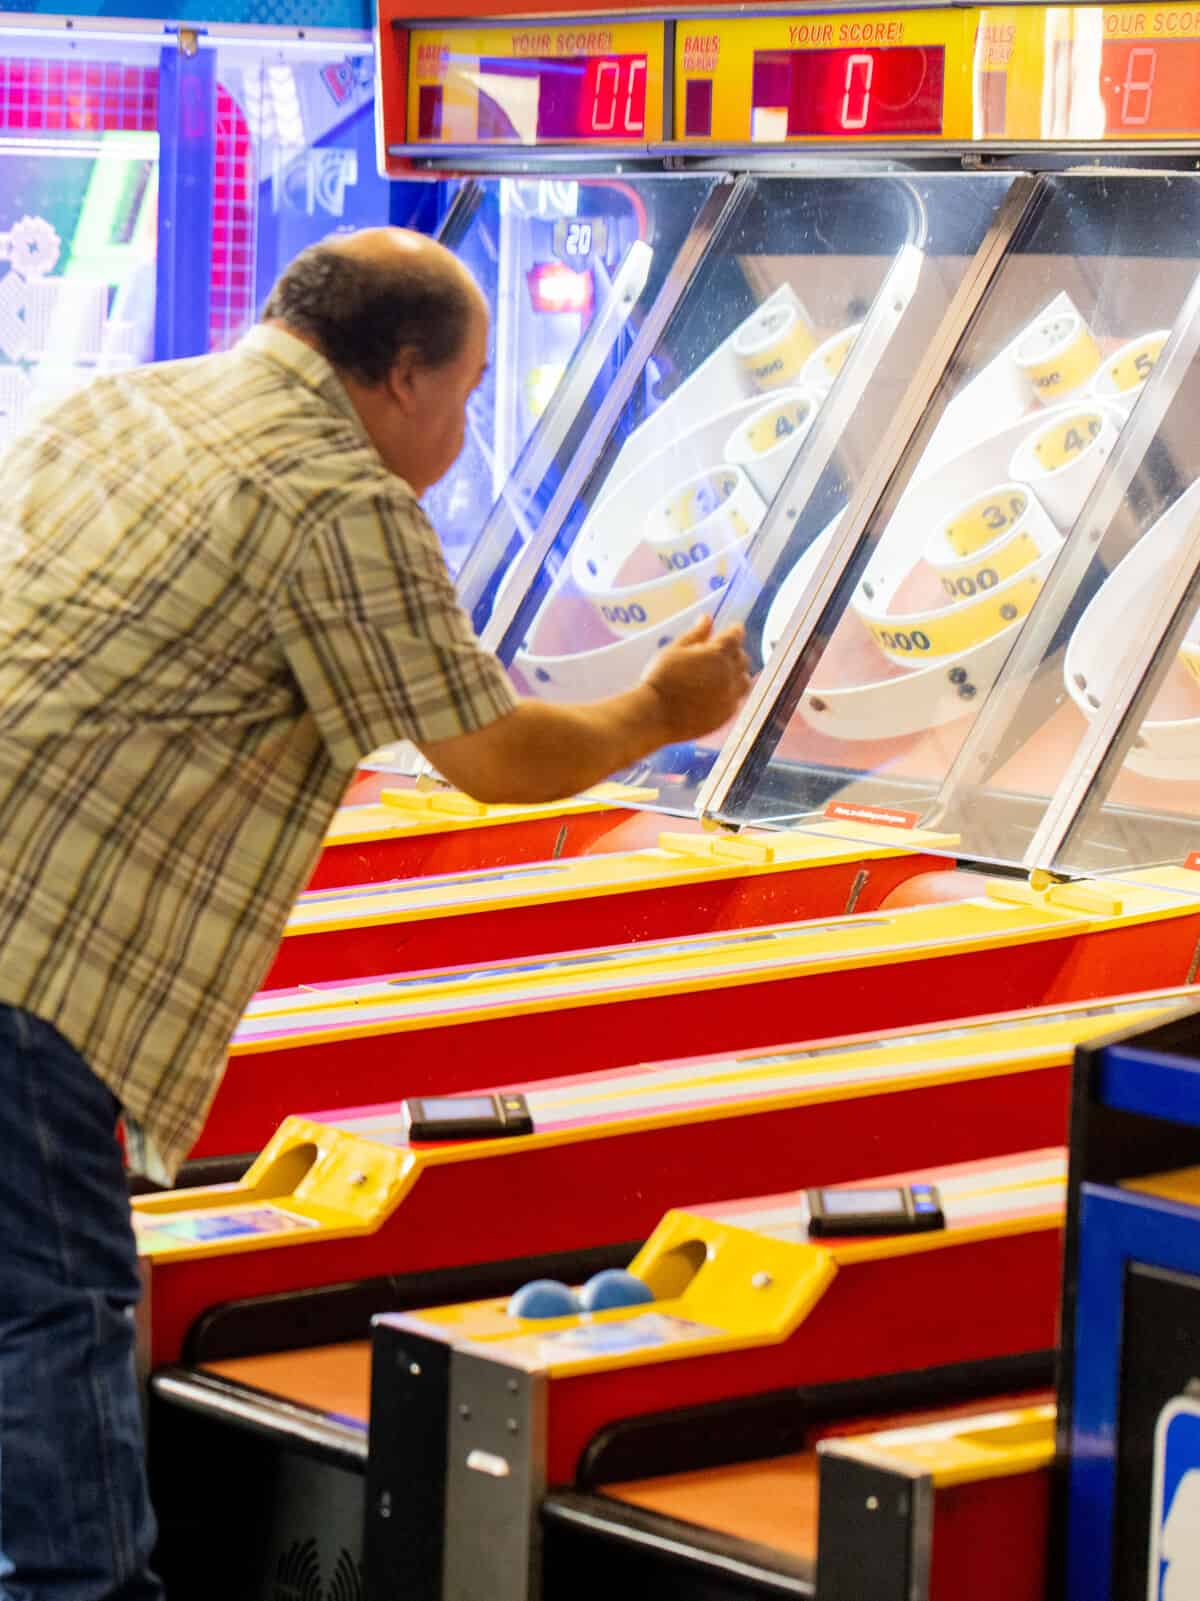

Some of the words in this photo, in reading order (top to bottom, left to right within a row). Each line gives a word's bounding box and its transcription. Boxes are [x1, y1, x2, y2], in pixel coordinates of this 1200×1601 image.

[788, 24, 833, 43] YOUR
[839, 22, 905, 42] SCORE!
[1101, 14, 1145, 33] OUR
[511, 33, 552, 53] YOUR
[556, 31, 613, 51] SCORE!
[841, 54, 874, 129] 0
[566, 223, 592, 256] 20
